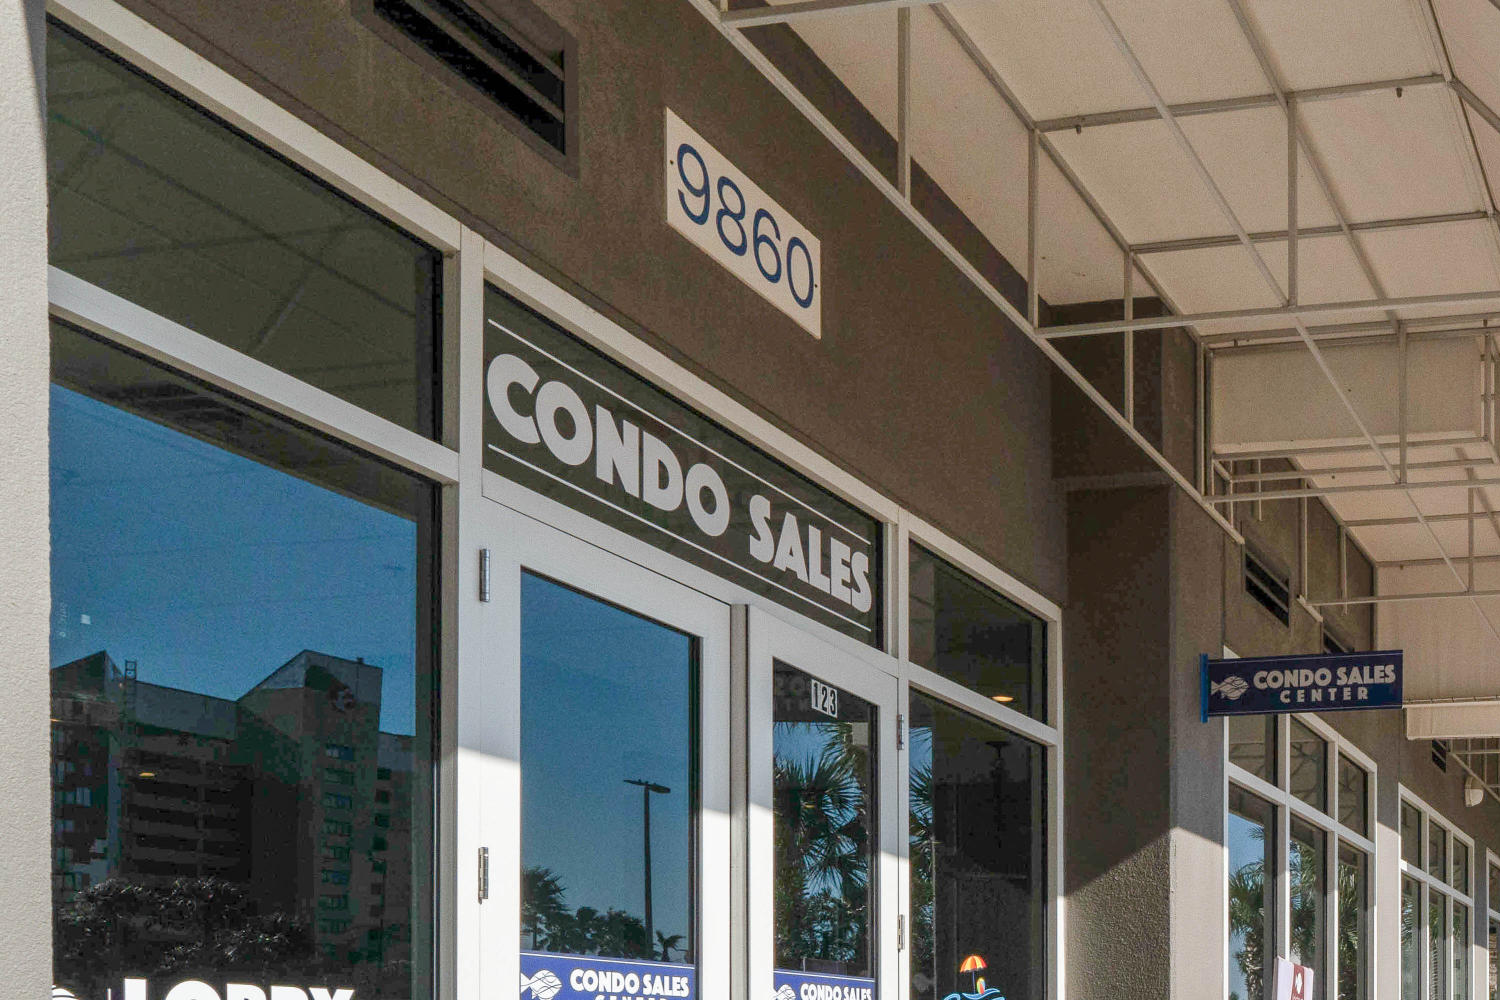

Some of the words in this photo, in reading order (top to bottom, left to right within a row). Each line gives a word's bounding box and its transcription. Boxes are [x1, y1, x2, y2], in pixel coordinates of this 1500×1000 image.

[676, 143, 815, 309] 9860
[486, 353, 731, 537] CONDO
[748, 494, 872, 613] SALES
[1252, 667, 1333, 690] CONDO
[1336, 664, 1397, 686] SALES
[813, 681, 837, 716] 123
[1279, 686, 1369, 704] CENTER
[569, 967, 640, 996] CONDO
[642, 973, 690, 998] SALES
